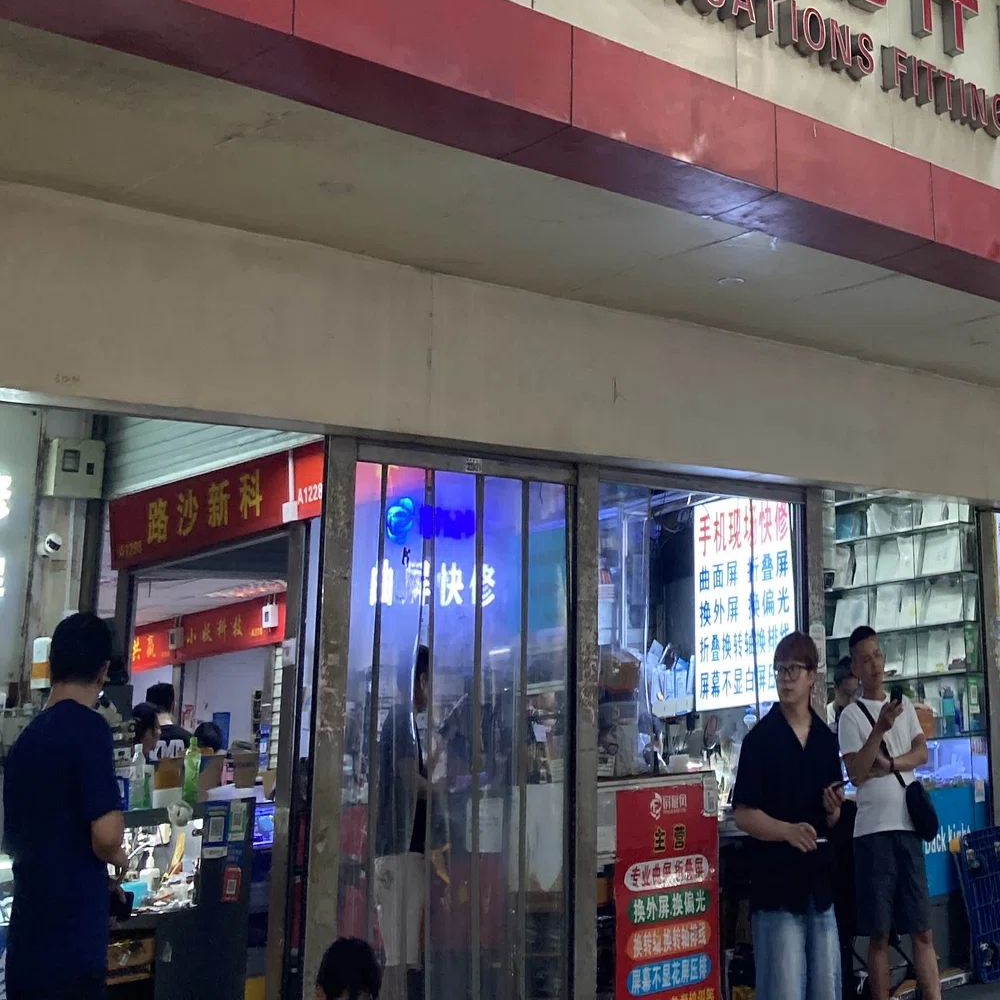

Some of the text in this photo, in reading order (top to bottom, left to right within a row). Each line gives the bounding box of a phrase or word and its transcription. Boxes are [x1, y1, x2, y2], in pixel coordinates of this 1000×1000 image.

[297, 482, 323, 506] A1228
[699, 501, 789, 557] 手机现场快修
[699, 550, 789, 593] 曲面屏 折叠屏
[699, 586, 790, 628] 换外屏 换偏光
[654, 824, 686, 853] 主营
